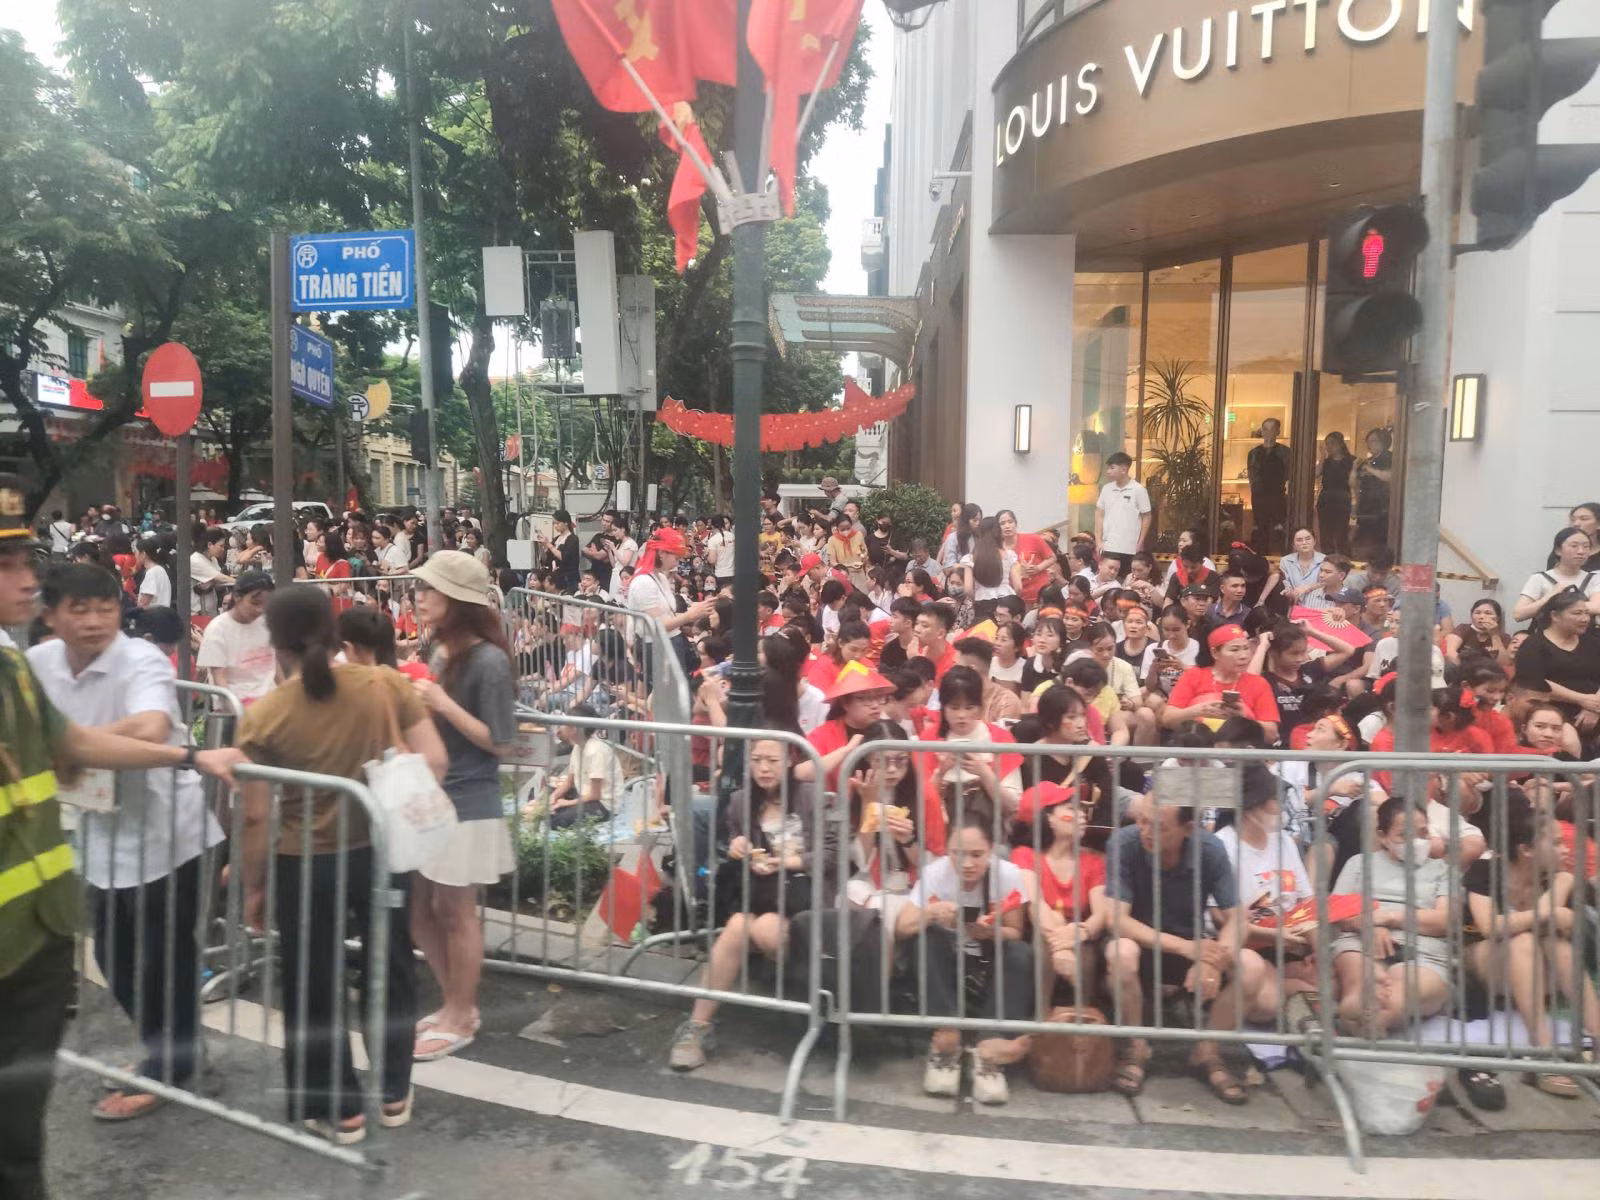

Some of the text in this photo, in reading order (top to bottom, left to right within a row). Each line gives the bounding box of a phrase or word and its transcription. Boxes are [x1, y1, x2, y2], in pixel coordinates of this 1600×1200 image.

[996, 62, 1099, 167] LOUIS
[342, 240, 381, 259] PHỐ
[299, 263, 403, 300] TRÀNG TIỀN
[668, 1143, 813, 1199] 154
